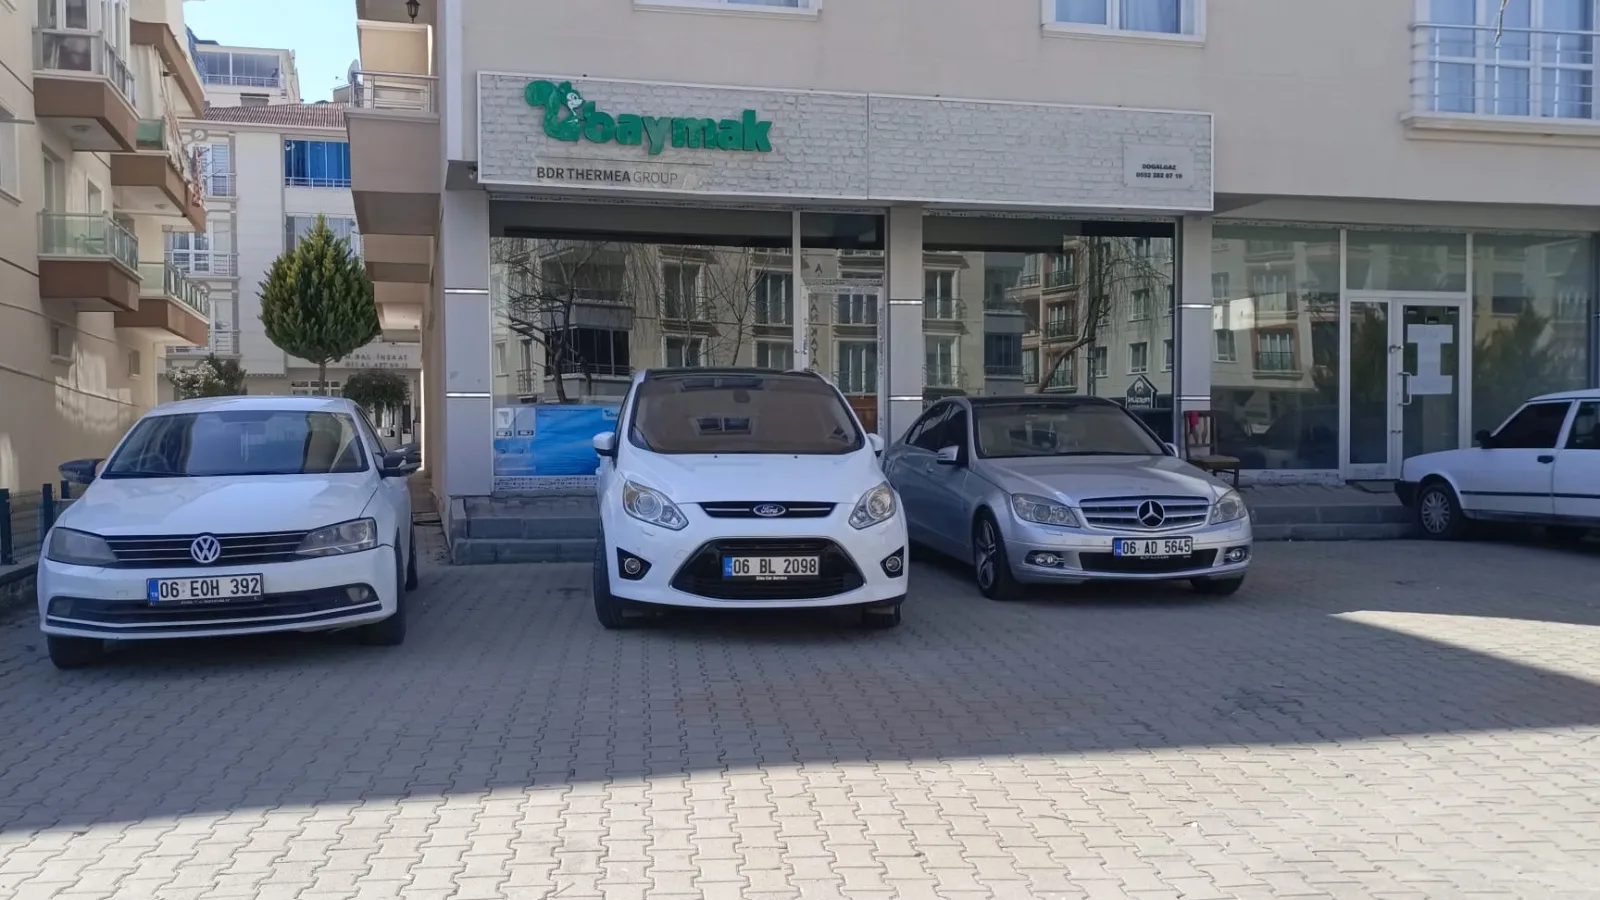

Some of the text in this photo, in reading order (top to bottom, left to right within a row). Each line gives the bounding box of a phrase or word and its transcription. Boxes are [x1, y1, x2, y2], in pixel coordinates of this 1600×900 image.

[582, 101, 773, 155] baymak
[537, 167, 678, 185] BDR THERMEA GROUP
[1122, 541, 1137, 555] 06
[1144, 541, 1158, 554] AD
[1164, 540, 1191, 554] 5645
[733, 558, 750, 574] 06
[759, 558, 776, 574] BL
[783, 558, 817, 574] 2098
[160, 582, 180, 598] 06
[190, 579, 220, 597] EOH
[230, 577, 260, 595] 392
